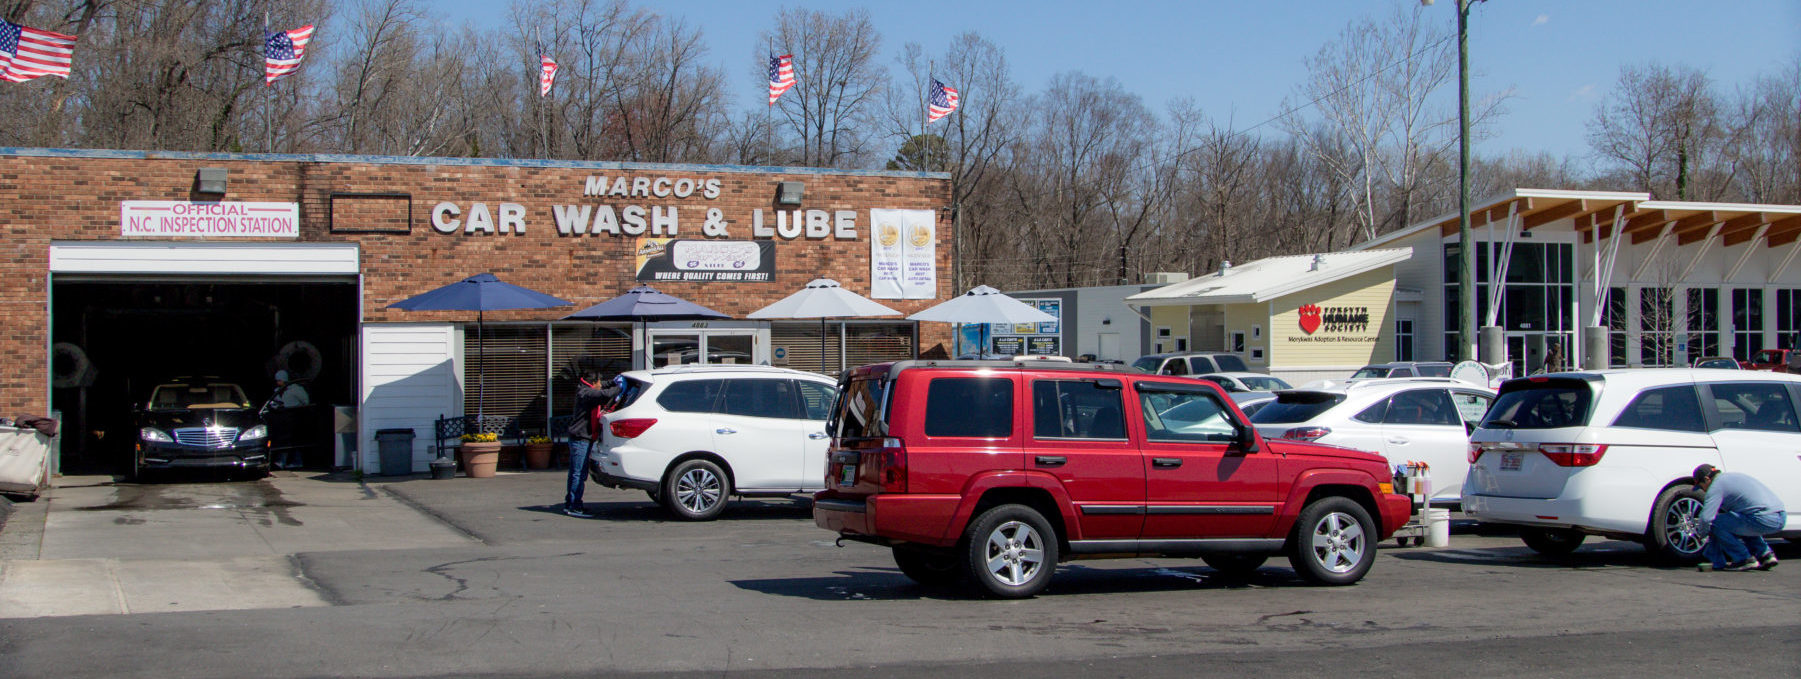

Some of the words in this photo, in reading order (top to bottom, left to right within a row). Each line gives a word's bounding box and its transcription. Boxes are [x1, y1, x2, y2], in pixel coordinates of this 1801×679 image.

[583, 175, 721, 199] MARCO'S
[172, 203, 248, 215] OFFICIAL
[129, 216, 155, 232] N.C.
[160, 216, 237, 233] INSPECTION
[240, 217, 292, 233] STATION
[431, 201, 527, 236] CAR
[552, 204, 679, 237] WASH
[702, 207, 729, 239] &
[752, 208, 858, 240] LUBE
[655, 271, 681, 280] WHERE
[683, 271, 714, 280] QUALITY
[716, 272, 742, 280] COMES
[744, 272, 769, 280] FIRST!
[1322, 314, 1369, 324] HUMANE
[1324, 324, 1367, 332] SOCIETY
